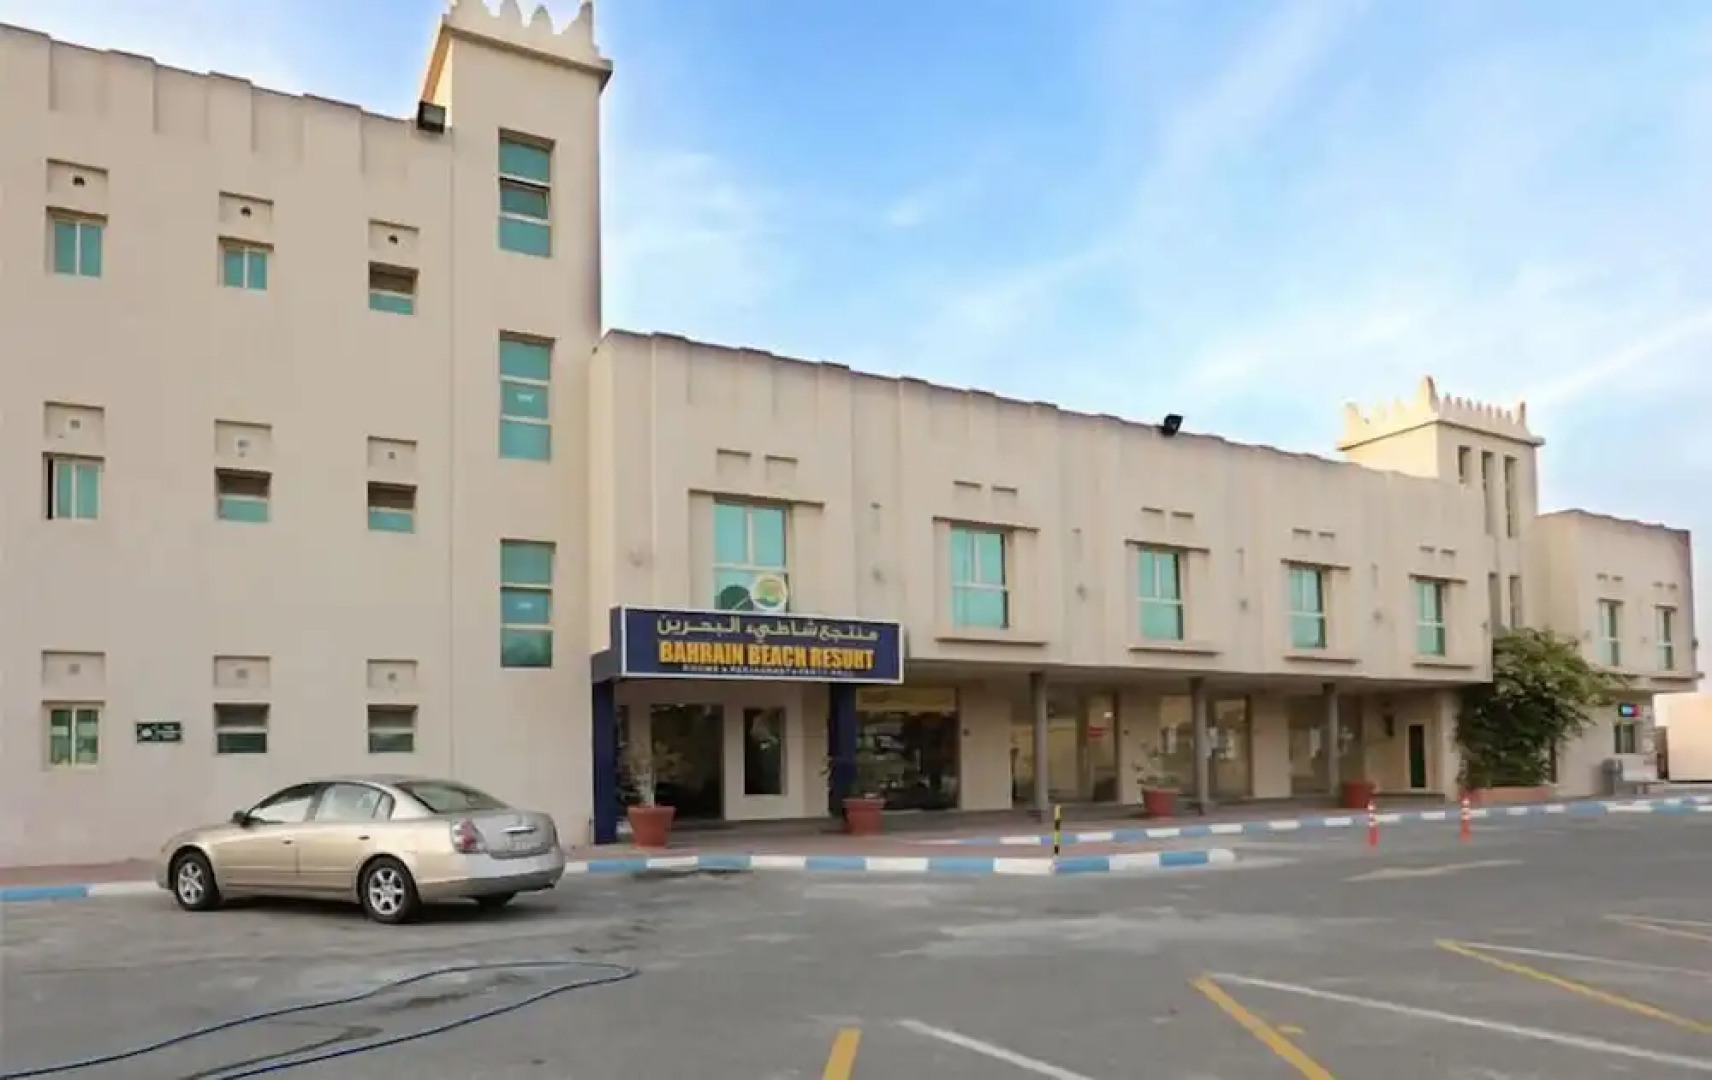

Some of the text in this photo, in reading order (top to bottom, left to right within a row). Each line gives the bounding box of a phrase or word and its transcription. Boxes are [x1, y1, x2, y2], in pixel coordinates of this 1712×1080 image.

[657, 615, 741, 638] البحرين
[659, 641, 876, 670] BAHRAIN BEACH RESORT
